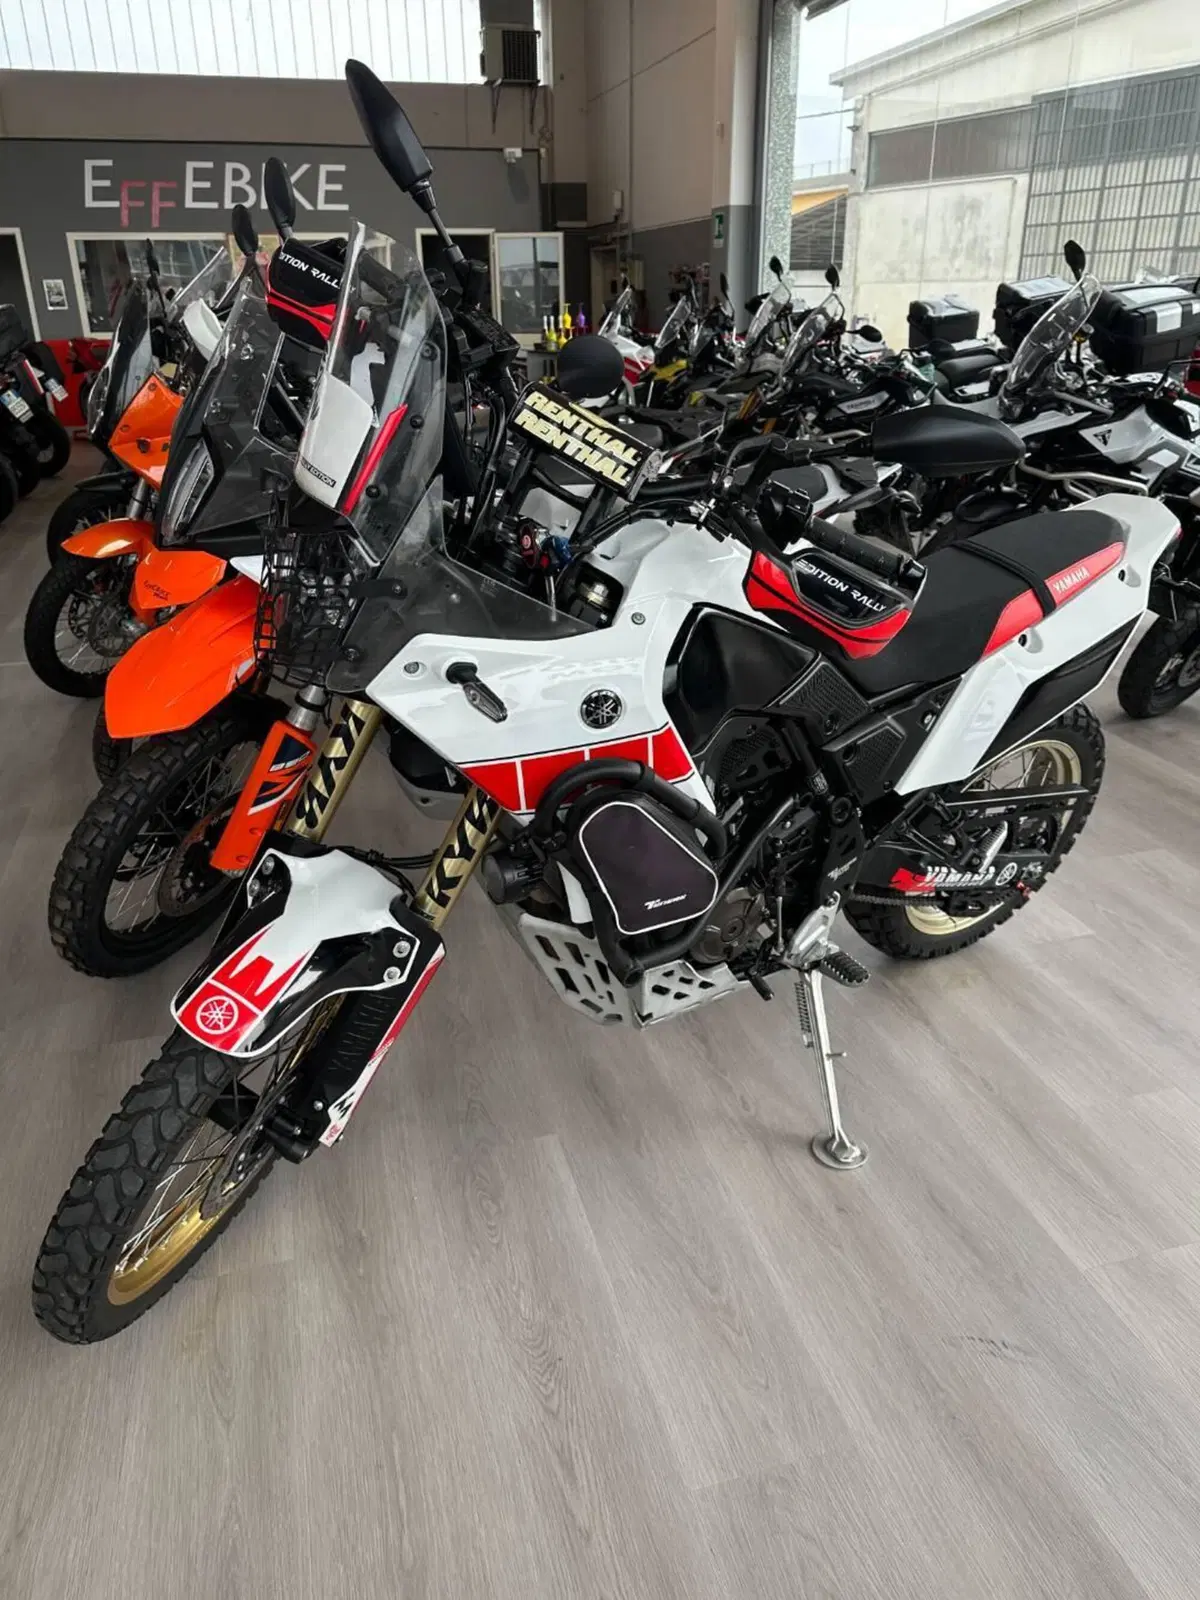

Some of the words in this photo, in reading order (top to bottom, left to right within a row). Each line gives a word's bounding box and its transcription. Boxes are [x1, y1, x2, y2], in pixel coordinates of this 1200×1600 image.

[514, 408, 630, 487] RENTHAL
[524, 391, 640, 467] RENTHAL
[796, 558, 849, 592] EDITION
[850, 589, 887, 612] RALLY
[1052, 565, 1090, 594] YAMAHA
[923, 865, 996, 885] YAMAHA
